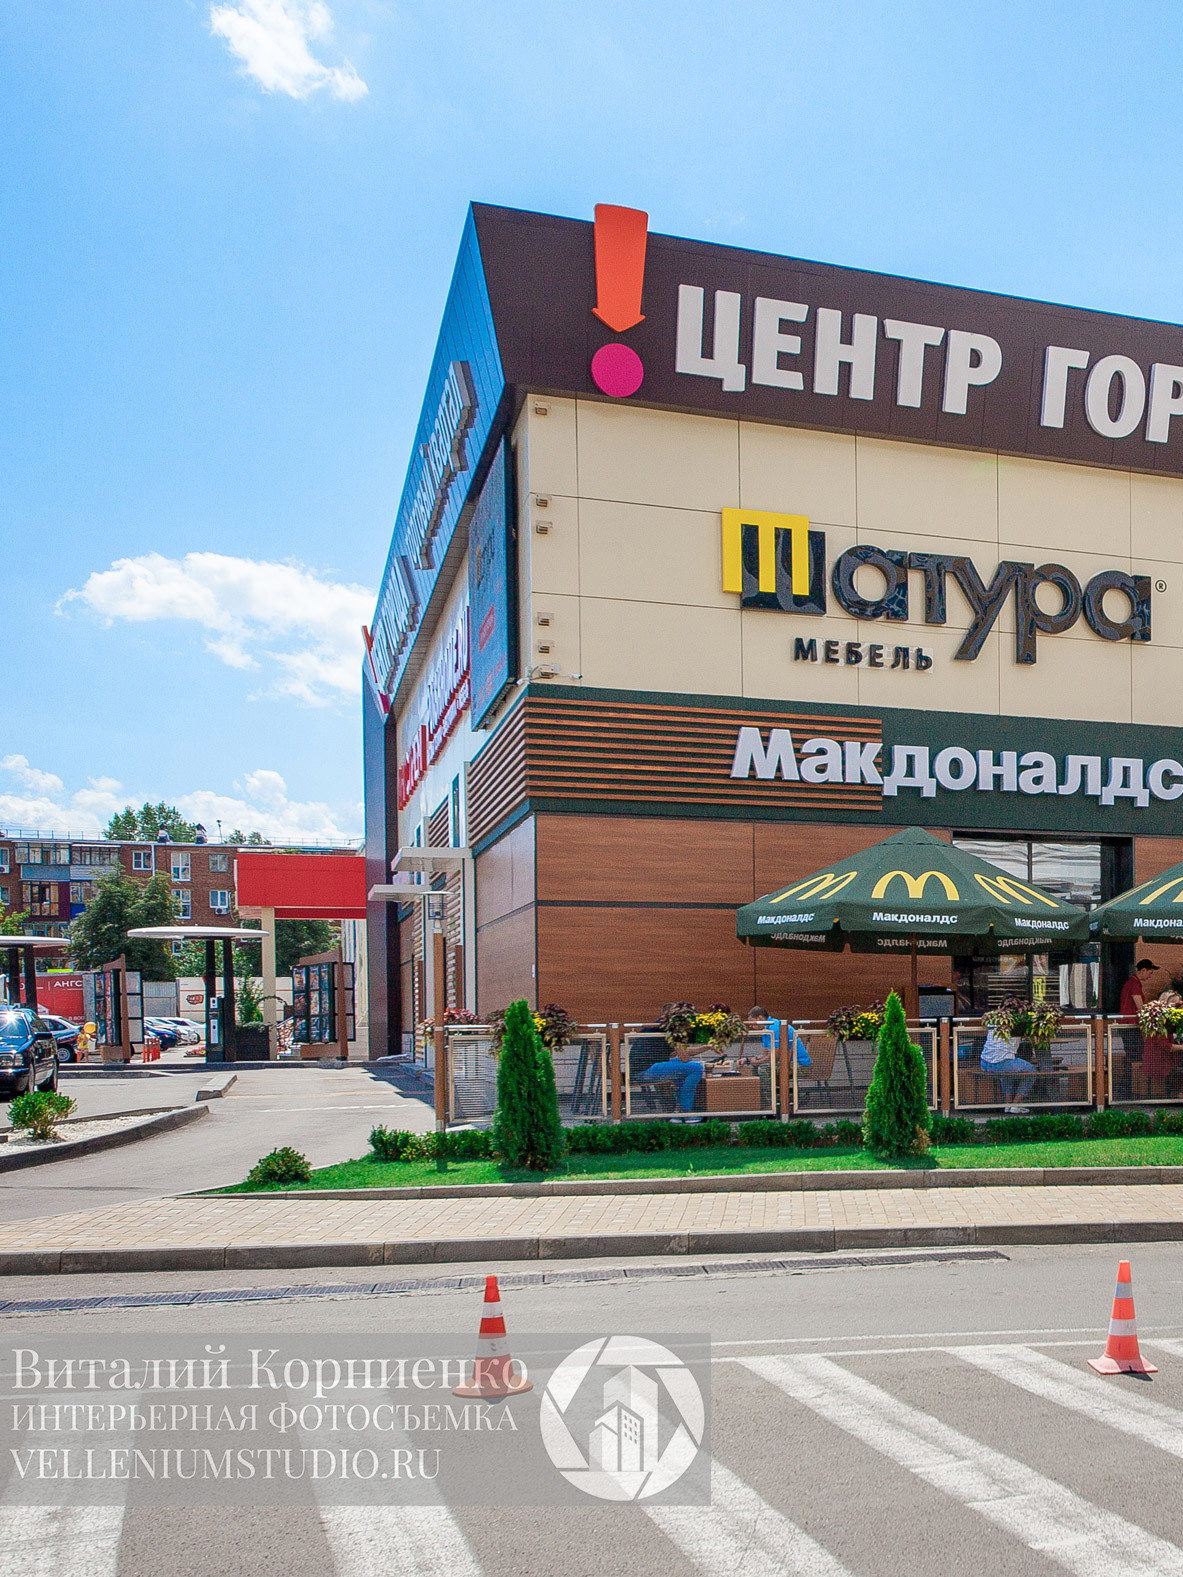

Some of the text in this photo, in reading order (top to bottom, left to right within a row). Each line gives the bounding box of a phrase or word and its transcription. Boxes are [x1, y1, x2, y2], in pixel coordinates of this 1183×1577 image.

[675, 283, 1003, 415] ЦЕНТР
[794, 636, 934, 672] МЕБЕЛЬ
[756, 912, 815, 925] Макдоналдс
[872, 911, 958, 925] Макдоналдс
[1014, 917, 1070, 930] Макдоналдс
